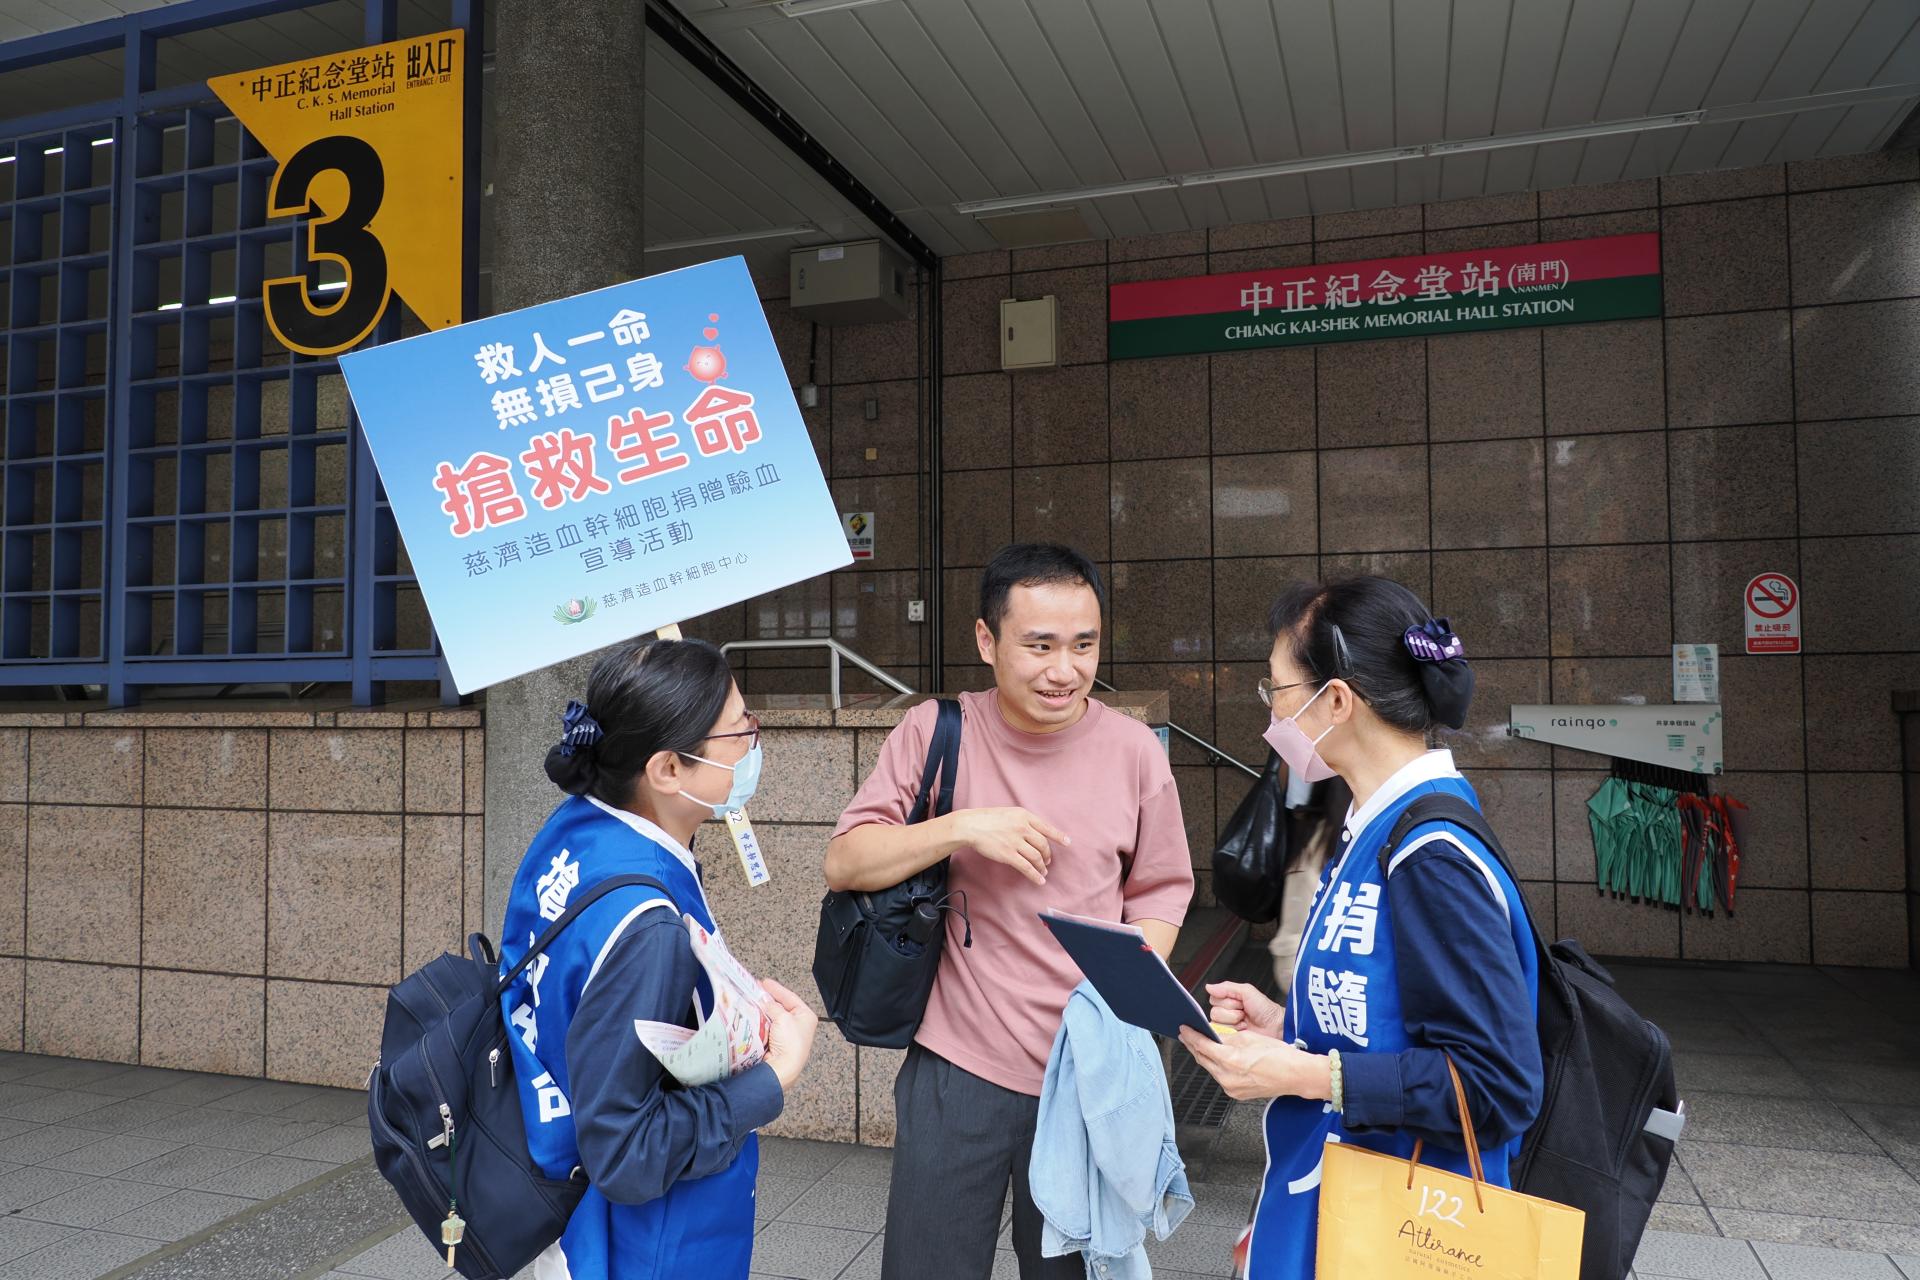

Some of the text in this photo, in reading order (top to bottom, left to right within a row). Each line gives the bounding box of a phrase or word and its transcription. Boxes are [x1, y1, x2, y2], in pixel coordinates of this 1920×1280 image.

[251, 51, 395, 102] 中正紀念堂站
[406, 77, 434, 89] ENTRANCE
[439, 74, 451, 84] EXIT
[407, 38, 452, 80] 出入口
[297, 82, 396, 110] C. K. S. Memorial
[330, 102, 395, 121] Hall Station
[268, 135, 388, 349] 3
[1240, 260, 1501, 317] 中正紀念堂站
[1517, 282, 1559, 294] NANMEN
[1224, 297, 1575, 340] CHIANG KAI-SHEK MEMORIAL HALL STATION
[474, 308, 652, 386] 救人一命
[491, 351, 665, 430] 無損己身
[433, 384, 764, 538] 搶救生命
[462, 462, 782, 578] 慈濟造血幹細胞捐贈驗血
[580, 519, 694, 574] 宣導活動
[601, 551, 749, 609] 慈濟造血幹細胞中心
[1551, 717, 1606, 730] raingo
[1418, 1185, 1466, 1228] 122
